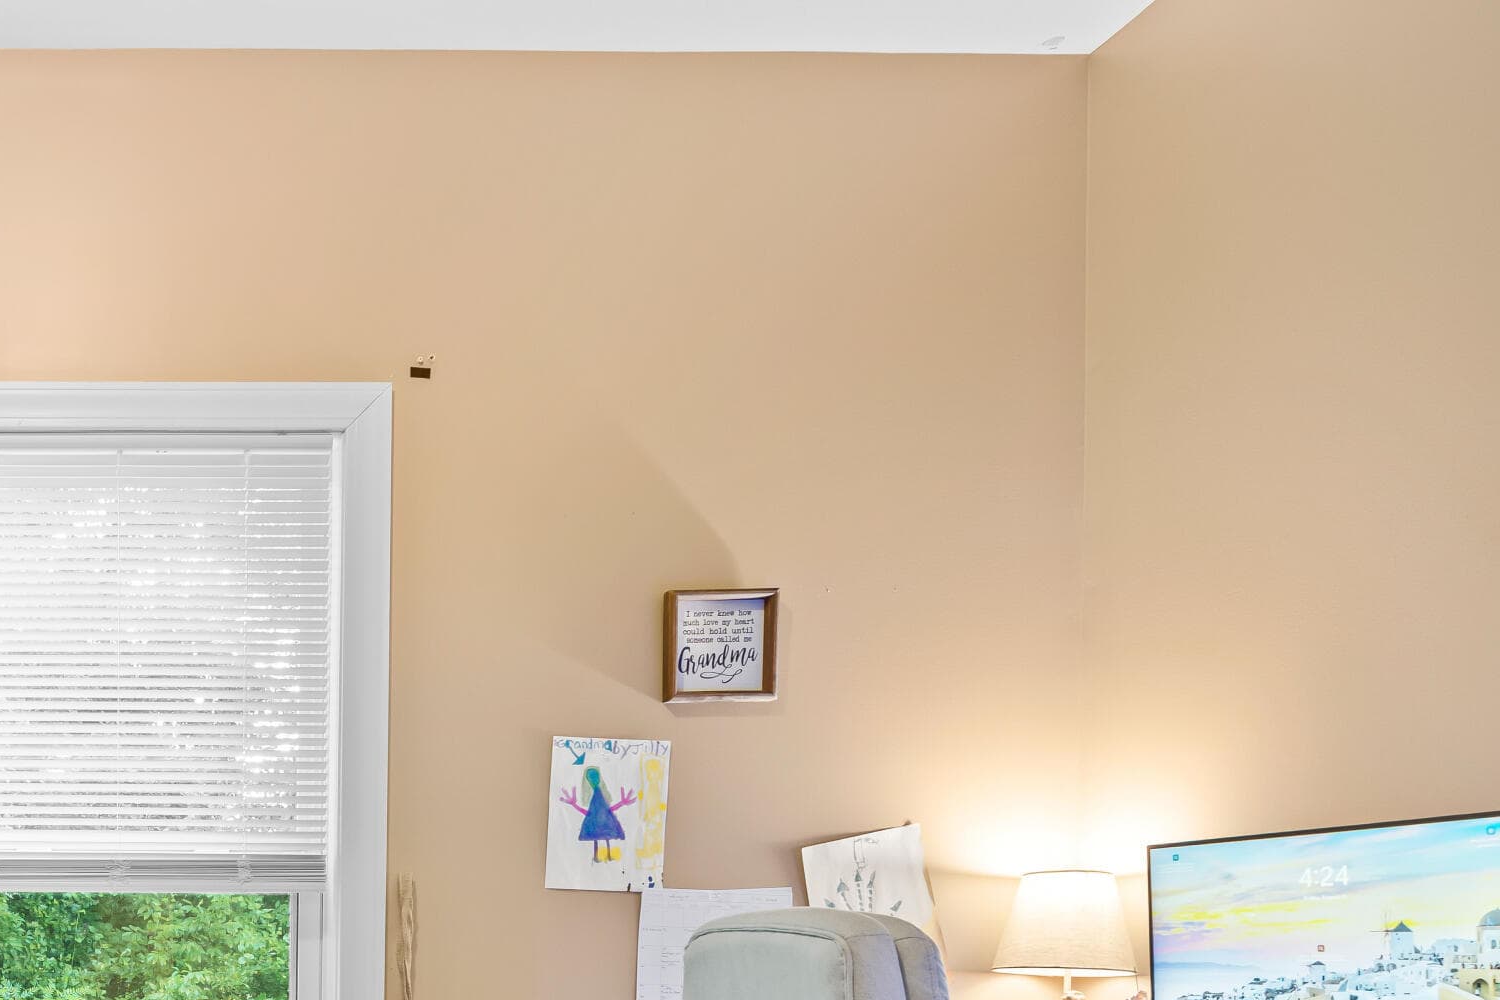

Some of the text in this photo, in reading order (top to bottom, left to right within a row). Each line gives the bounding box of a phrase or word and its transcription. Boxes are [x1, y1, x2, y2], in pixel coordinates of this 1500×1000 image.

[732, 626, 754, 634] until
[678, 644, 758, 683] Grandma
[1299, 864, 1349, 887] 4:24
